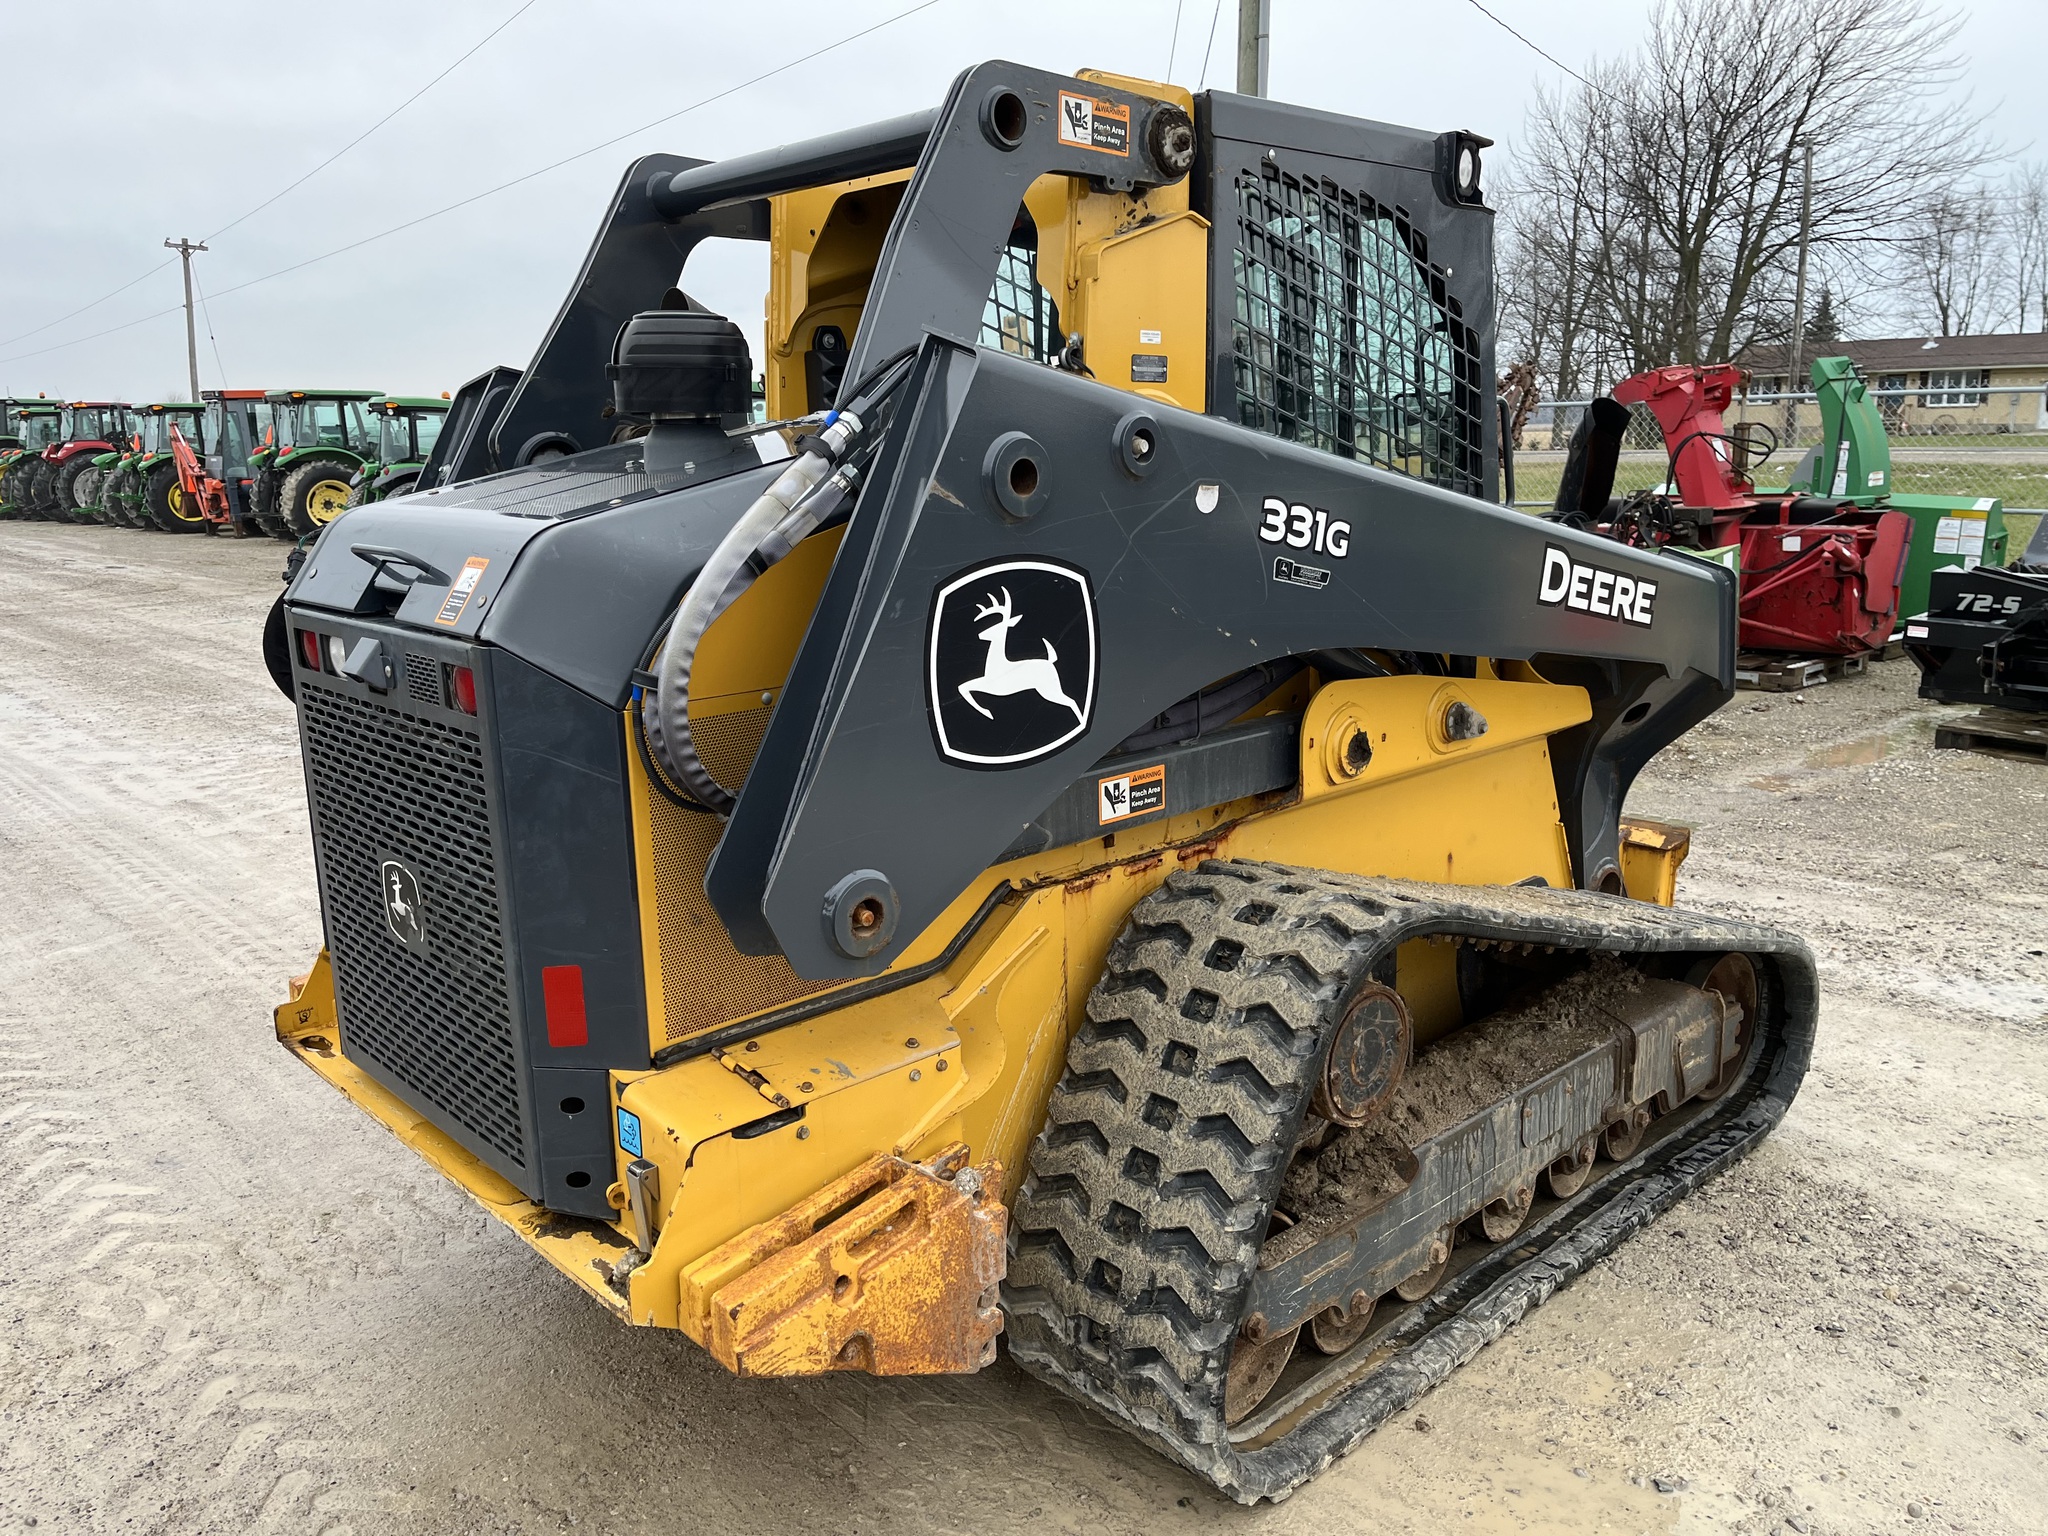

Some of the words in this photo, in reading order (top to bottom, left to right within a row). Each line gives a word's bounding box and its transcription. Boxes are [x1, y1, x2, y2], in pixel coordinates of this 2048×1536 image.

[1100, 105, 1126, 117] WARNING
[1094, 121, 1110, 132] Pinch
[1111, 125, 1125, 136] Area
[1094, 133, 1106, 143] Keep
[1107, 136, 1121, 146] Away
[1260, 498, 1350, 557] 331G
[1540, 547, 1656, 625] DEERE
[1956, 593, 2022, 614] 72-S
[1137, 770, 1161, 780] WARNING
[1131, 789, 1147, 798] Pinch
[1148, 786, 1161, 795] Area
